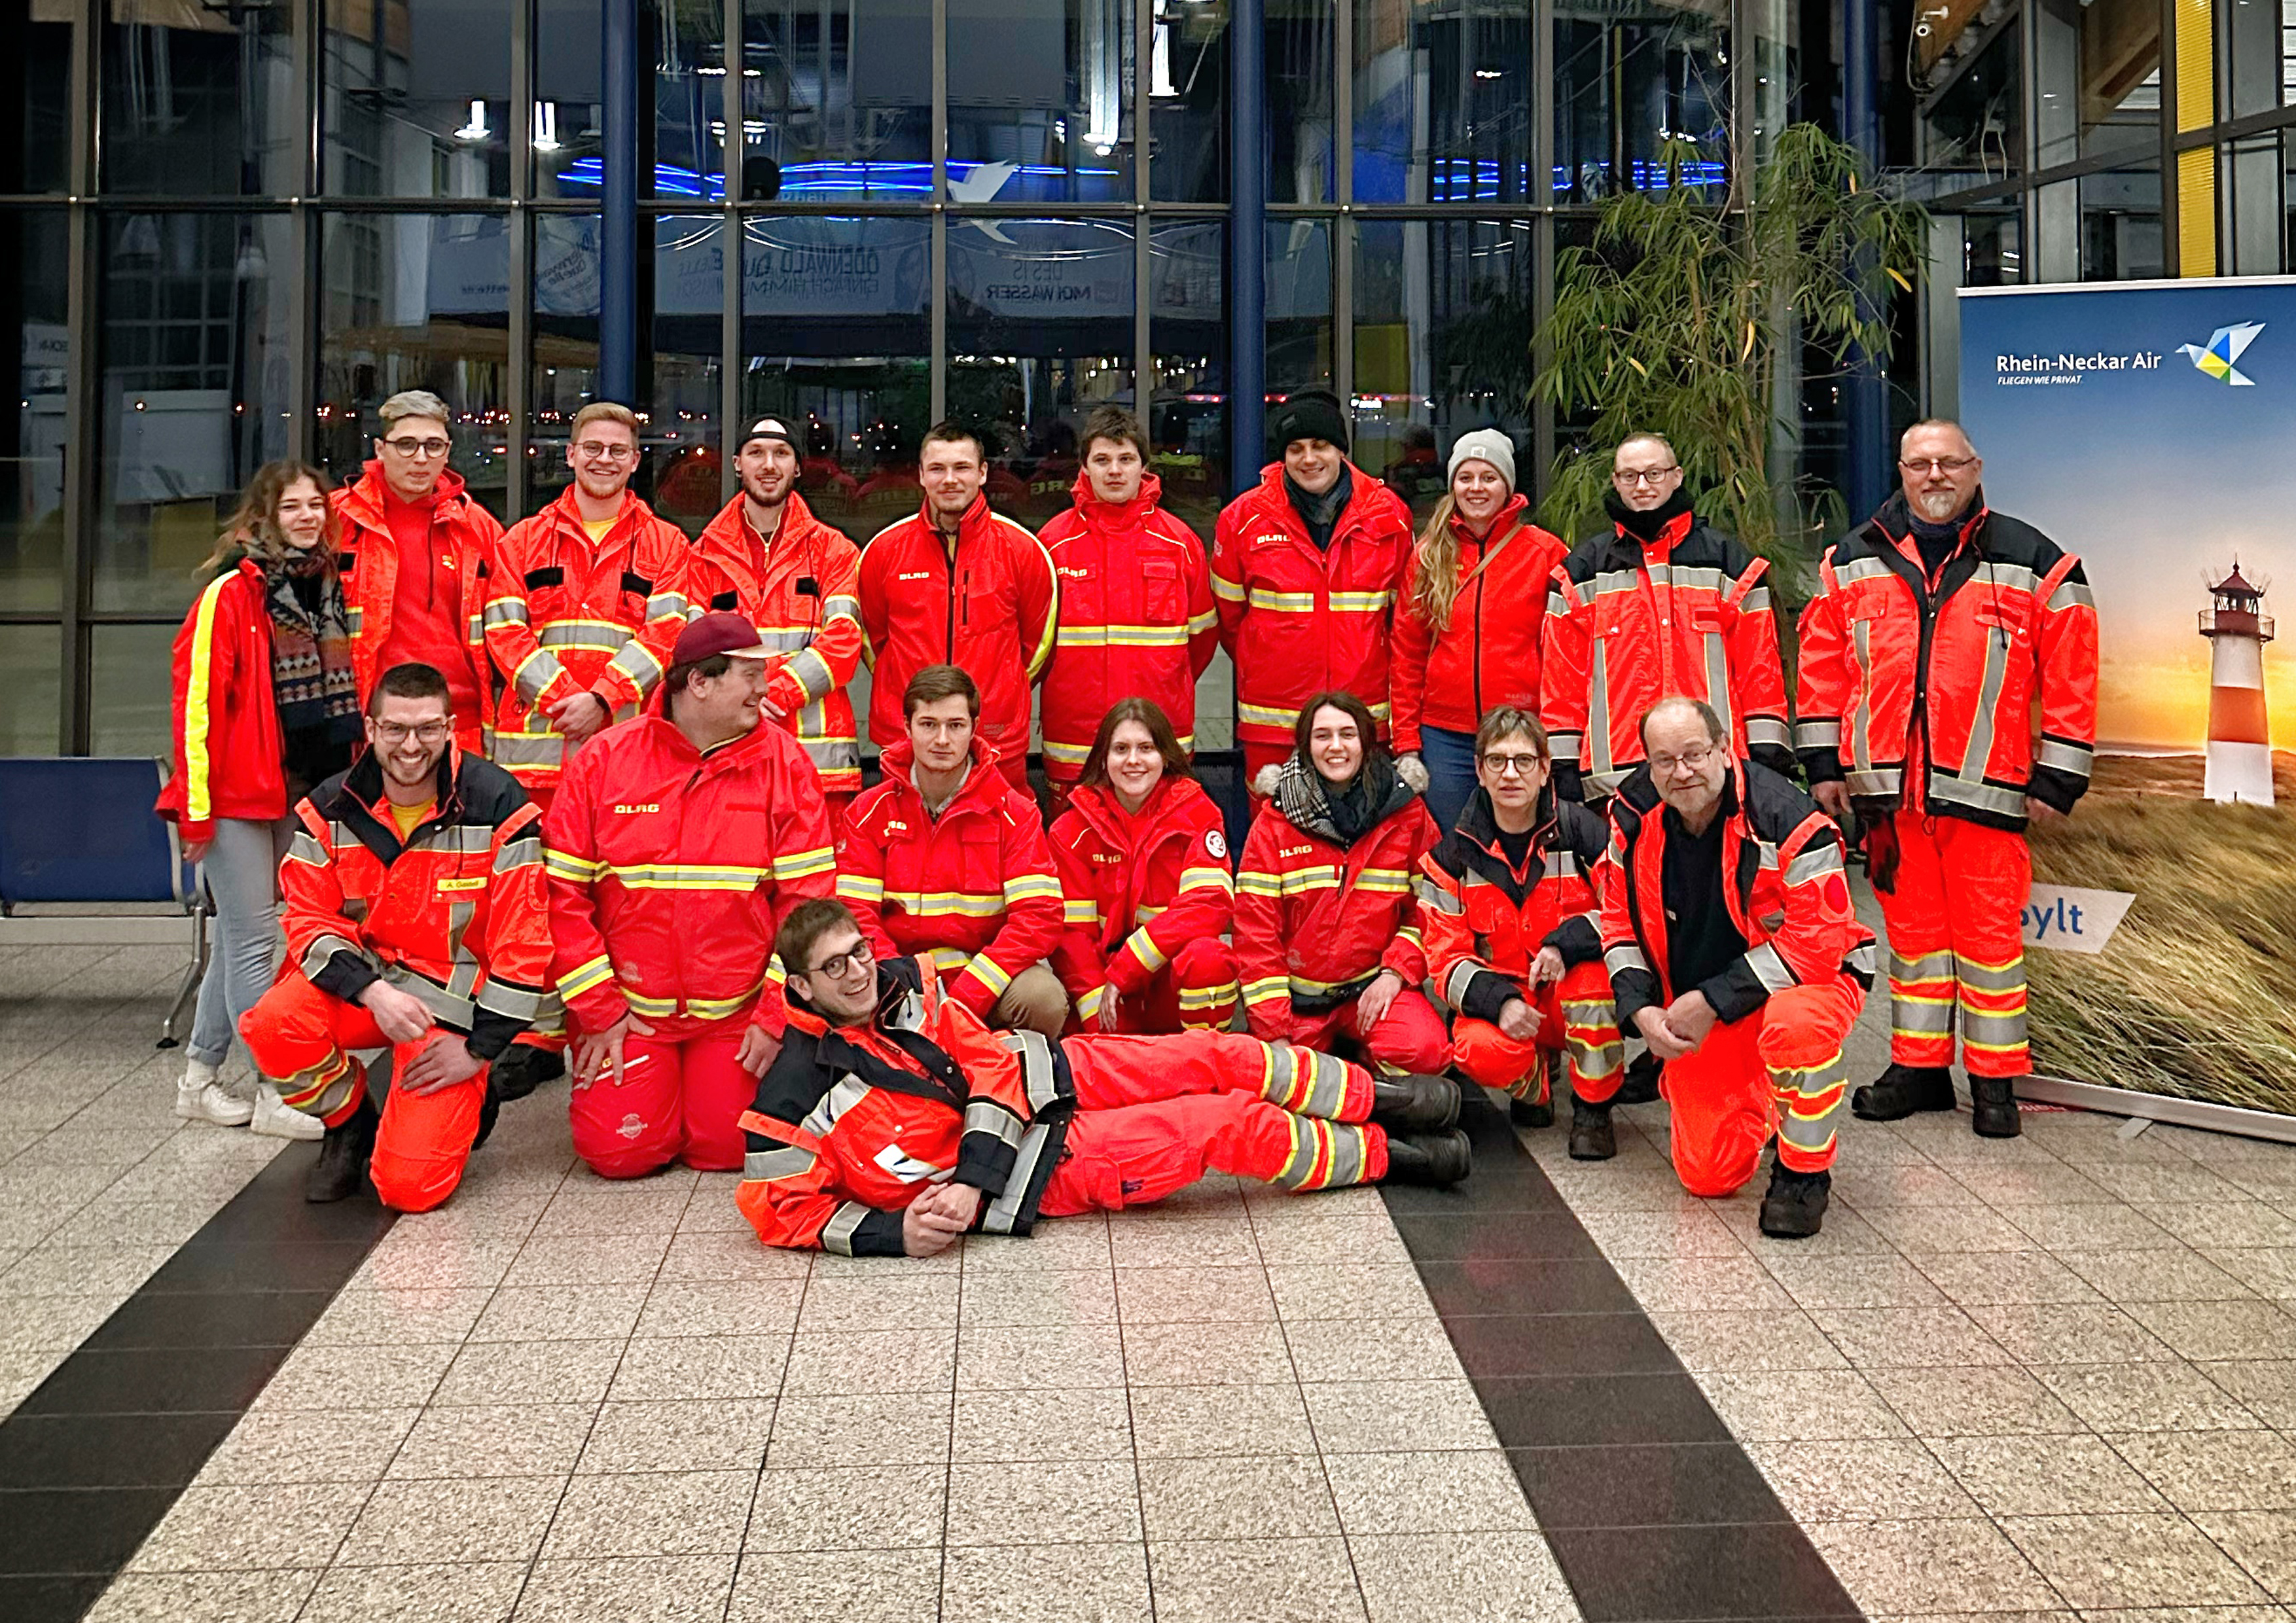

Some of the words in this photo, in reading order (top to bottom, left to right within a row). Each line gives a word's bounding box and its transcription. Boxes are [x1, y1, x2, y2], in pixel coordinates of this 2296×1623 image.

[1996, 352, 2129, 372] Rhein-Neckar
[2132, 351, 2162, 370] Air
[1998, 376, 2033, 385] FLIEGEN
[2034, 375, 2050, 385] WIE
[899, 571, 929, 580] DLRG
[615, 804, 660, 814] DLRG
